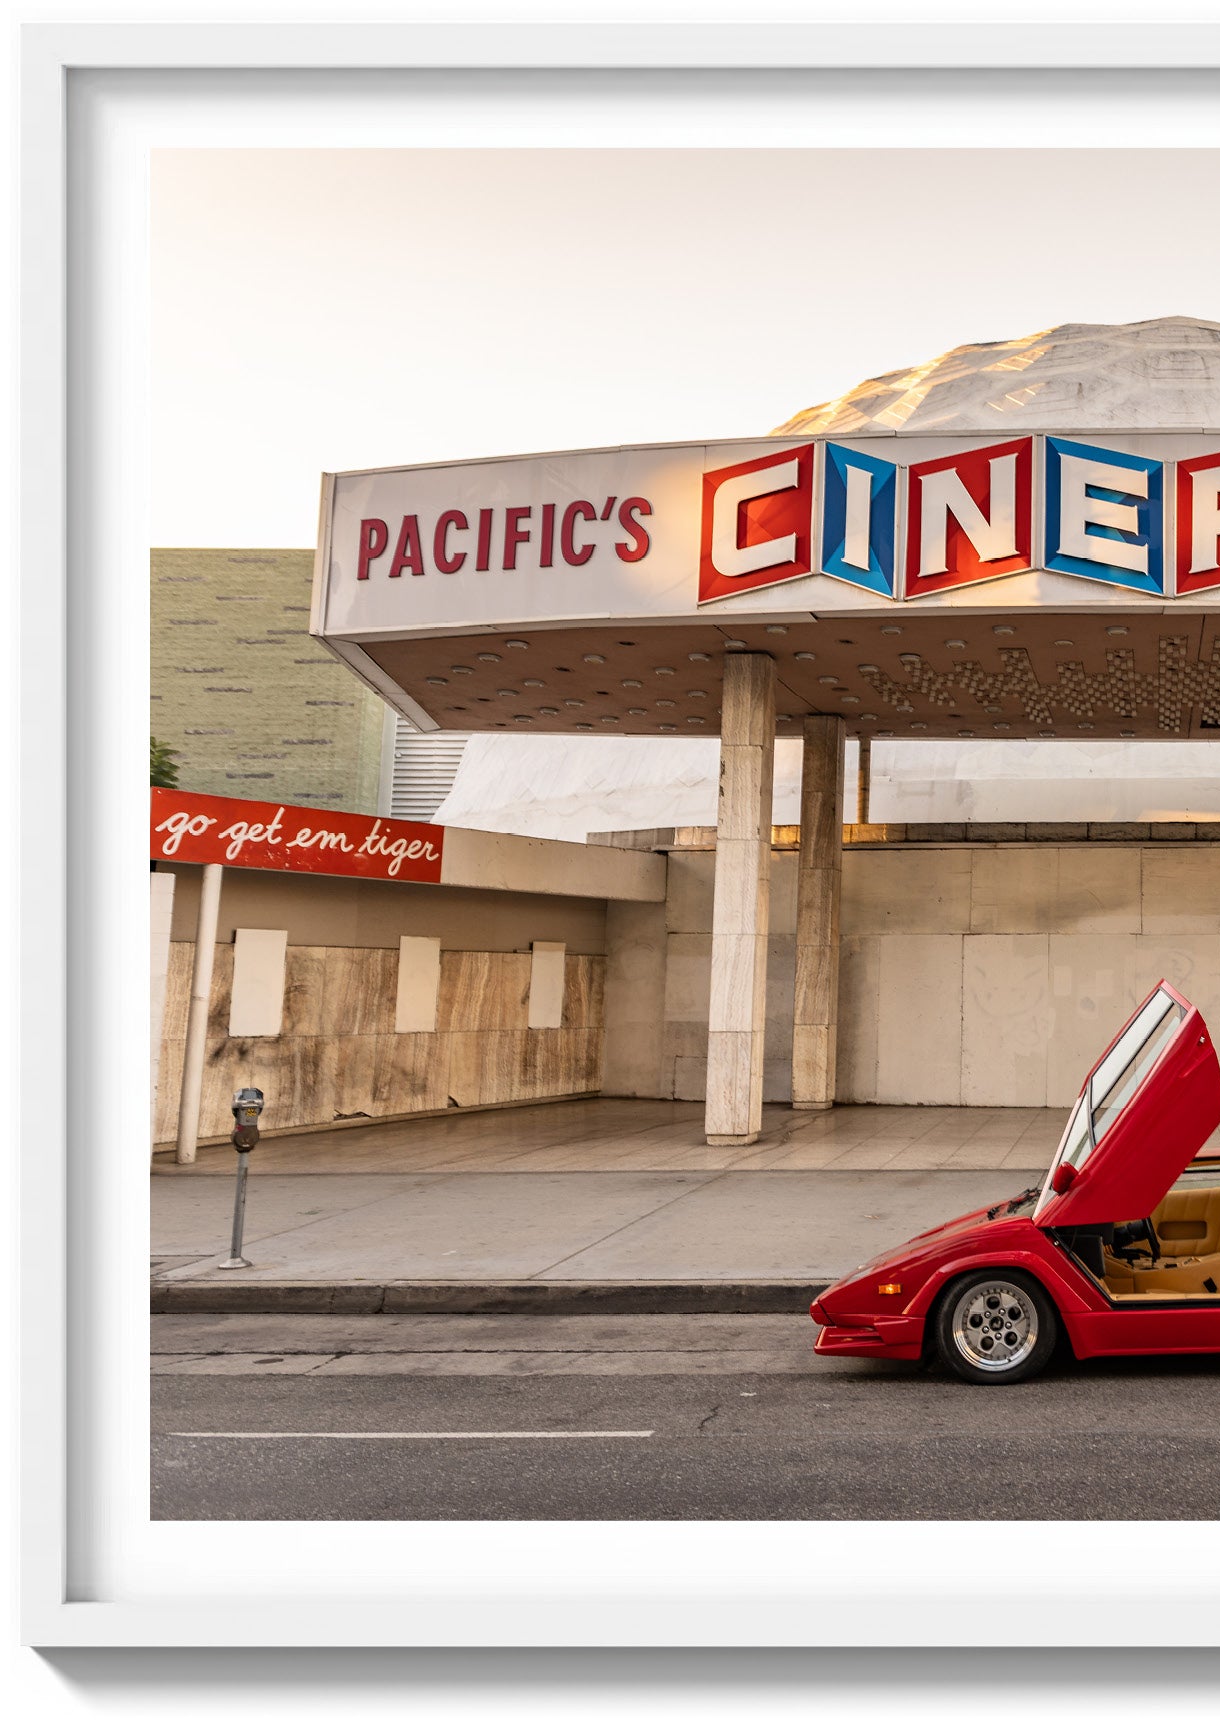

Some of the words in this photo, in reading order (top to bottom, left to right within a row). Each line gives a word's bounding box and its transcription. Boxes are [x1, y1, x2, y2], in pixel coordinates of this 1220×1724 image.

[357, 496, 652, 581] PACIFIC'S
[155, 811, 217, 856] go
[218, 806, 285, 860] get
[285, 827, 354, 853] em
[357, 818, 439, 876] tiger
